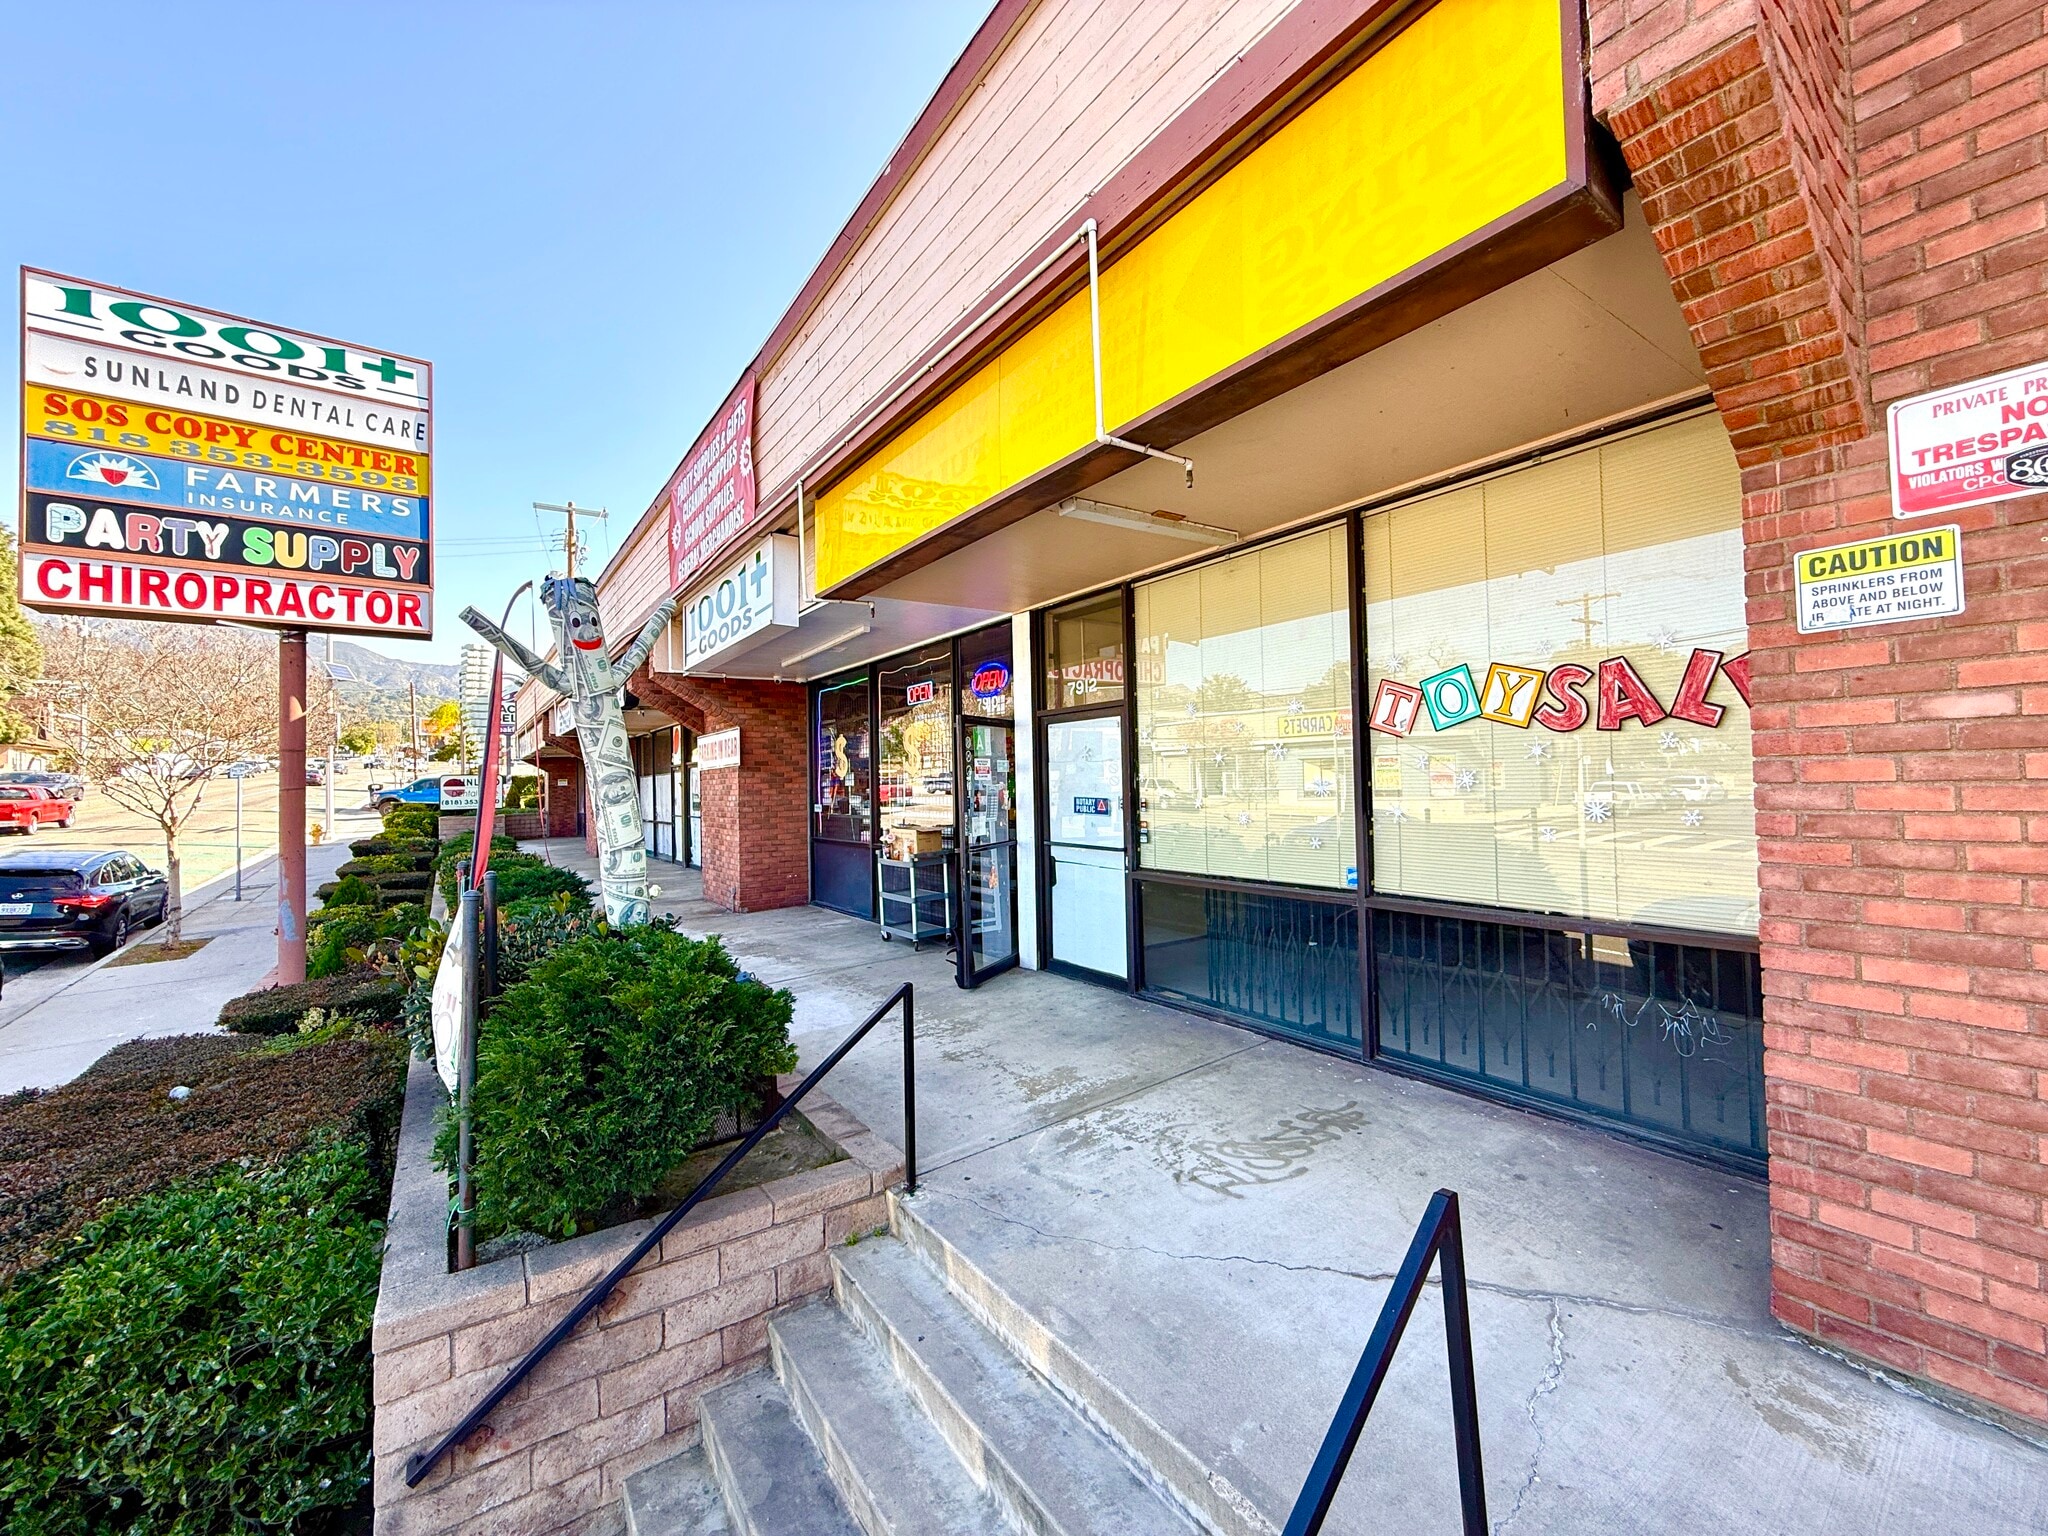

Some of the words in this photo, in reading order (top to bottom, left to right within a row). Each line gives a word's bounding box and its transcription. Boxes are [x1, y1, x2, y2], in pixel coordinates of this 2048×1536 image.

[54, 285, 414, 384] 1001+
[120, 330, 366, 390] GOODS
[85, 356, 240, 405] SUNLAND
[253, 389, 355, 428] DENTAL
[365, 412, 426, 442] CARE
[726, 398, 747, 440] GIFTS
[1932, 386, 2009, 418] PRIVATE
[43, 392, 128, 427] SOS
[145, 411, 258, 448] COPY
[270, 437, 419, 477] CENTER
[43, 420, 151, 449] 818
[169, 440, 418, 492] 353-3593
[1911, 422, 2048, 467] TRESPA
[187, 466, 412, 516] FARMERS
[1908, 461, 1984, 489] VIOLATORS
[187, 491, 349, 525] INSURANCE
[46, 502, 230, 560] PARTY
[242, 526, 420, 580] SUPPLY
[1808, 535, 1944, 578] CAUTION
[36, 558, 423, 627] CHIROPRACTOR
[1811, 574, 1895, 597] SPRINKLERS
[1900, 567, 1943, 584] FROM
[1811, 594, 1856, 610] ABOVE
[1859, 590, 1888, 603] AND
[1892, 581, 1944, 599] BELOW
[1876, 604, 1892, 615] AT
[1897, 596, 1945, 613] NIGHT.
[699, 608, 752, 654] GOODS
[909, 683, 931, 703] OPEN
[973, 669, 1007, 691] OPEN
[1067, 677, 1098, 696] 7912
[1380, 668, 1536, 730] TOY
[1532, 647, 1751, 733] SAL
[1075, 805, 1096, 813] PUBLIC
